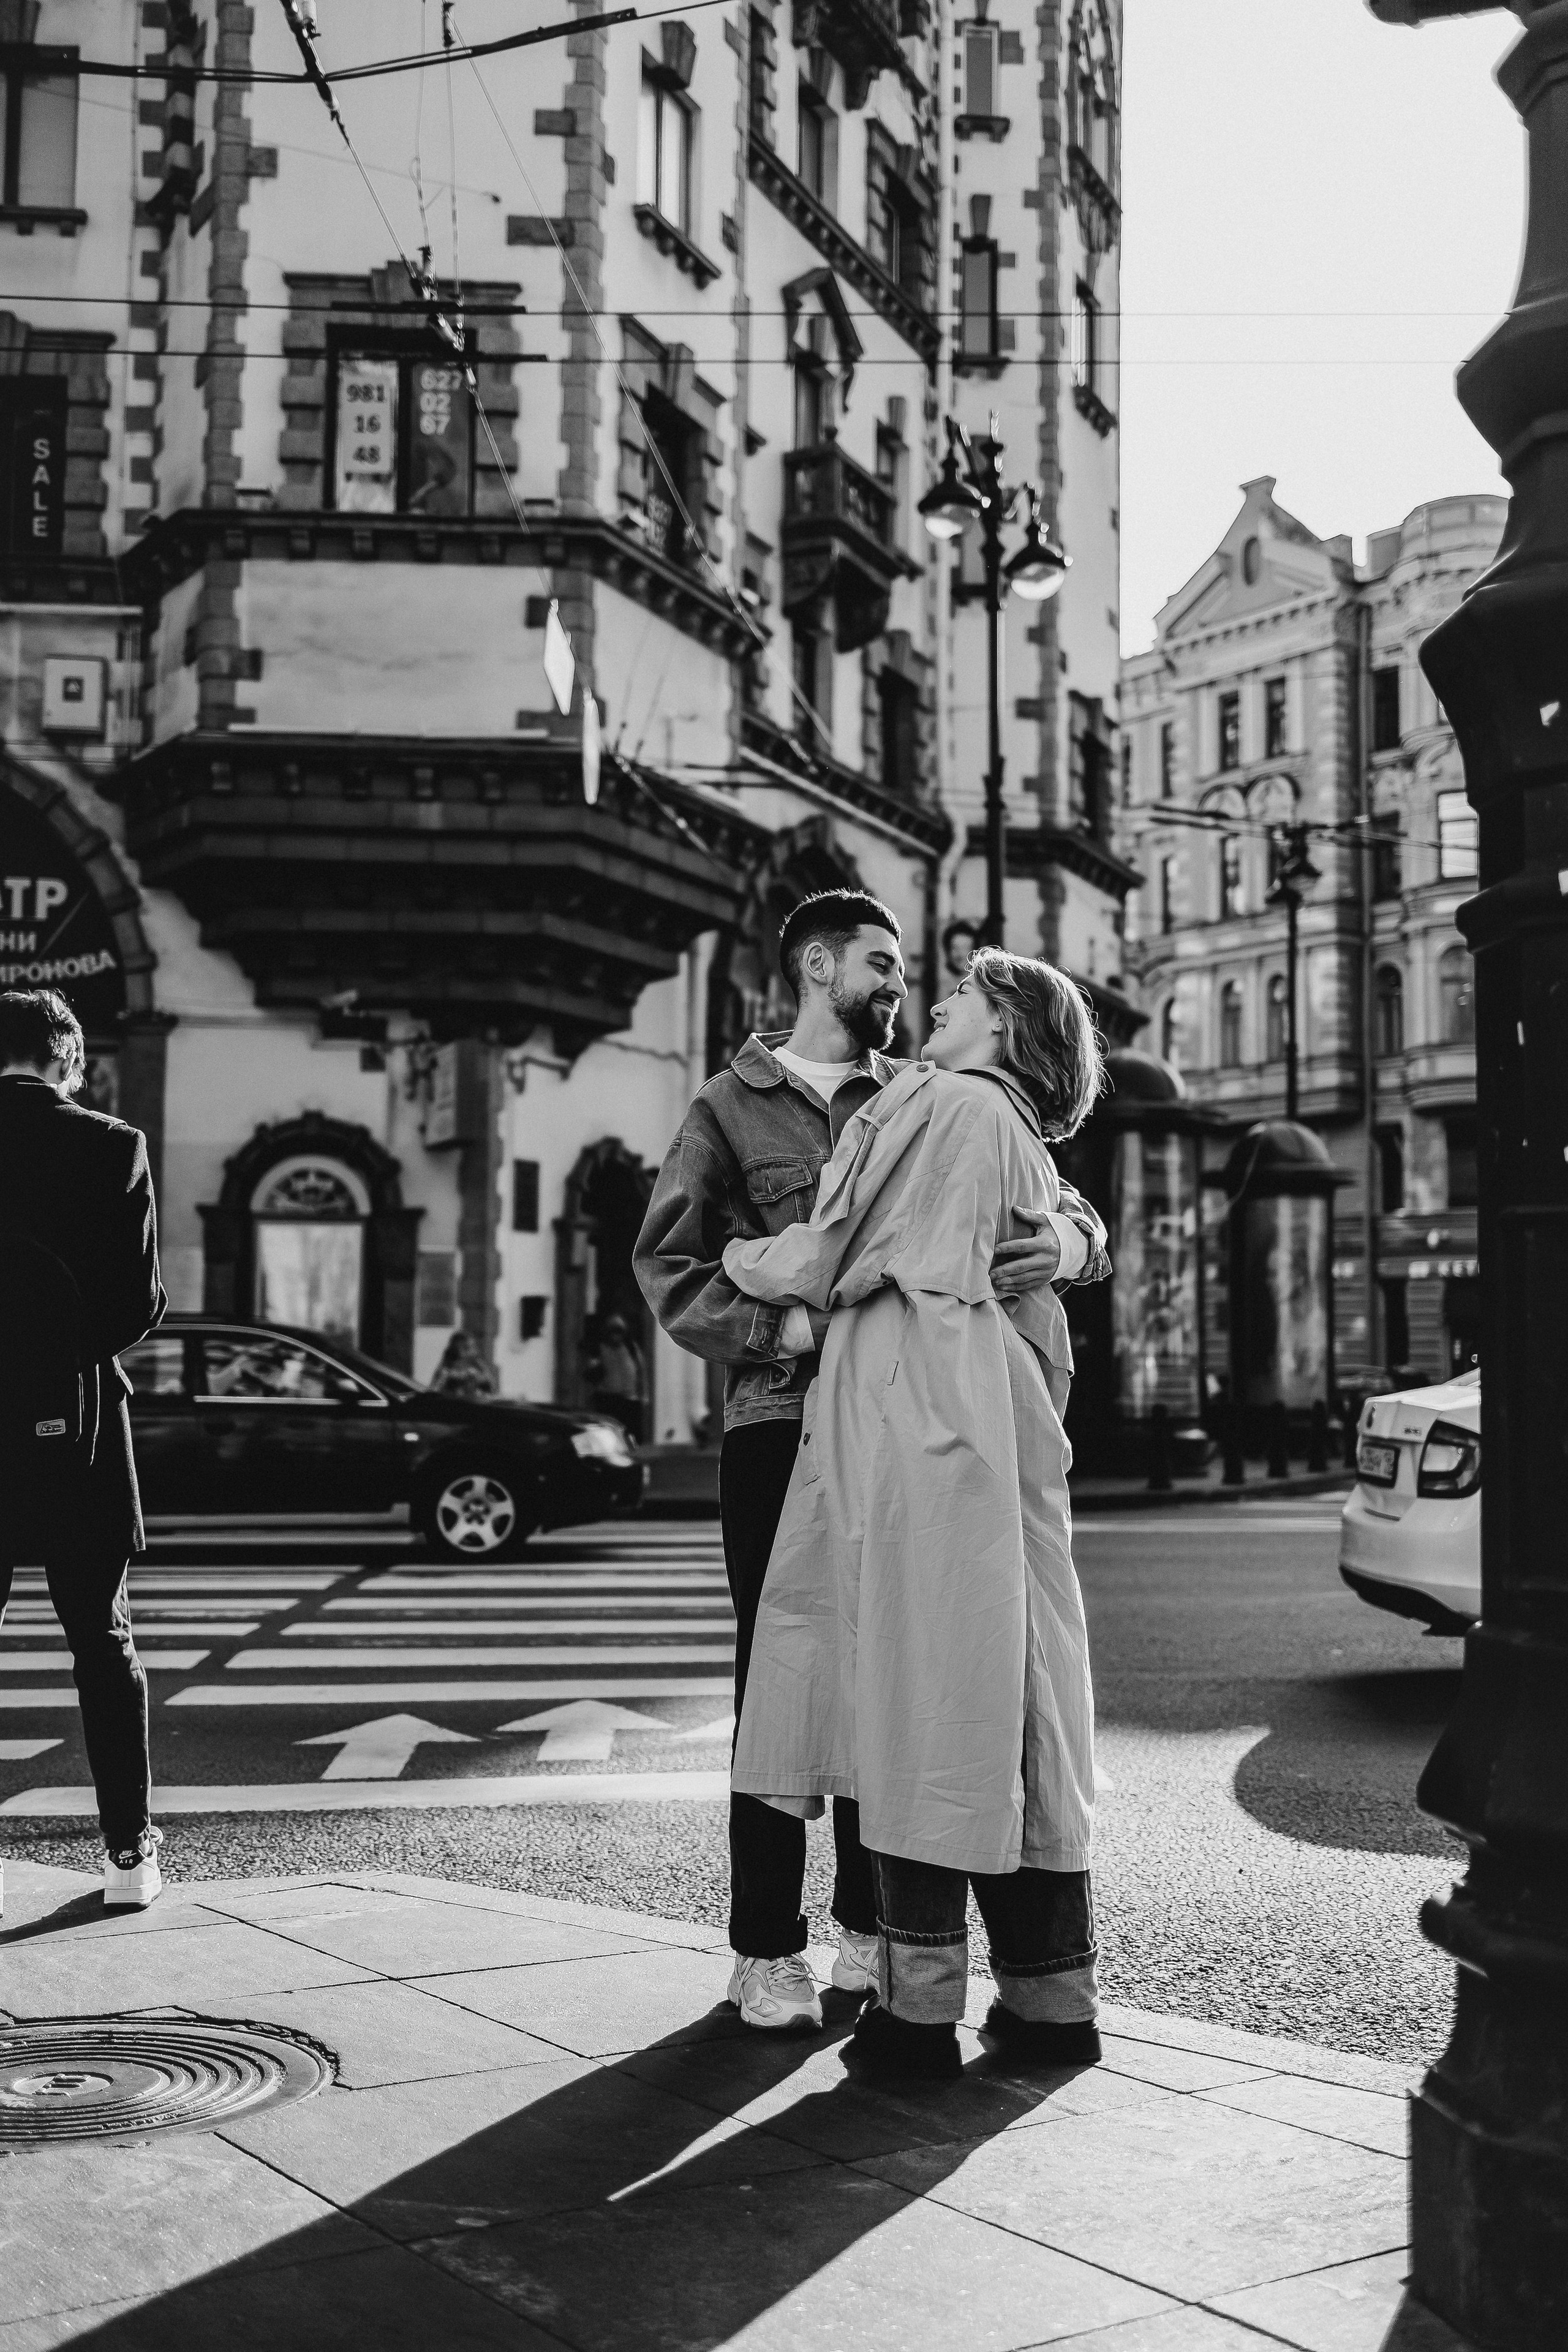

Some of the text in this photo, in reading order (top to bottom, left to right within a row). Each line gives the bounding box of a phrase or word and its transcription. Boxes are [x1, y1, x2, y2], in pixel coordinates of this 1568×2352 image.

[353, 413, 381, 434] 16
[32, 437, 51, 538] SALE
[0, 876, 69, 920] ТР
